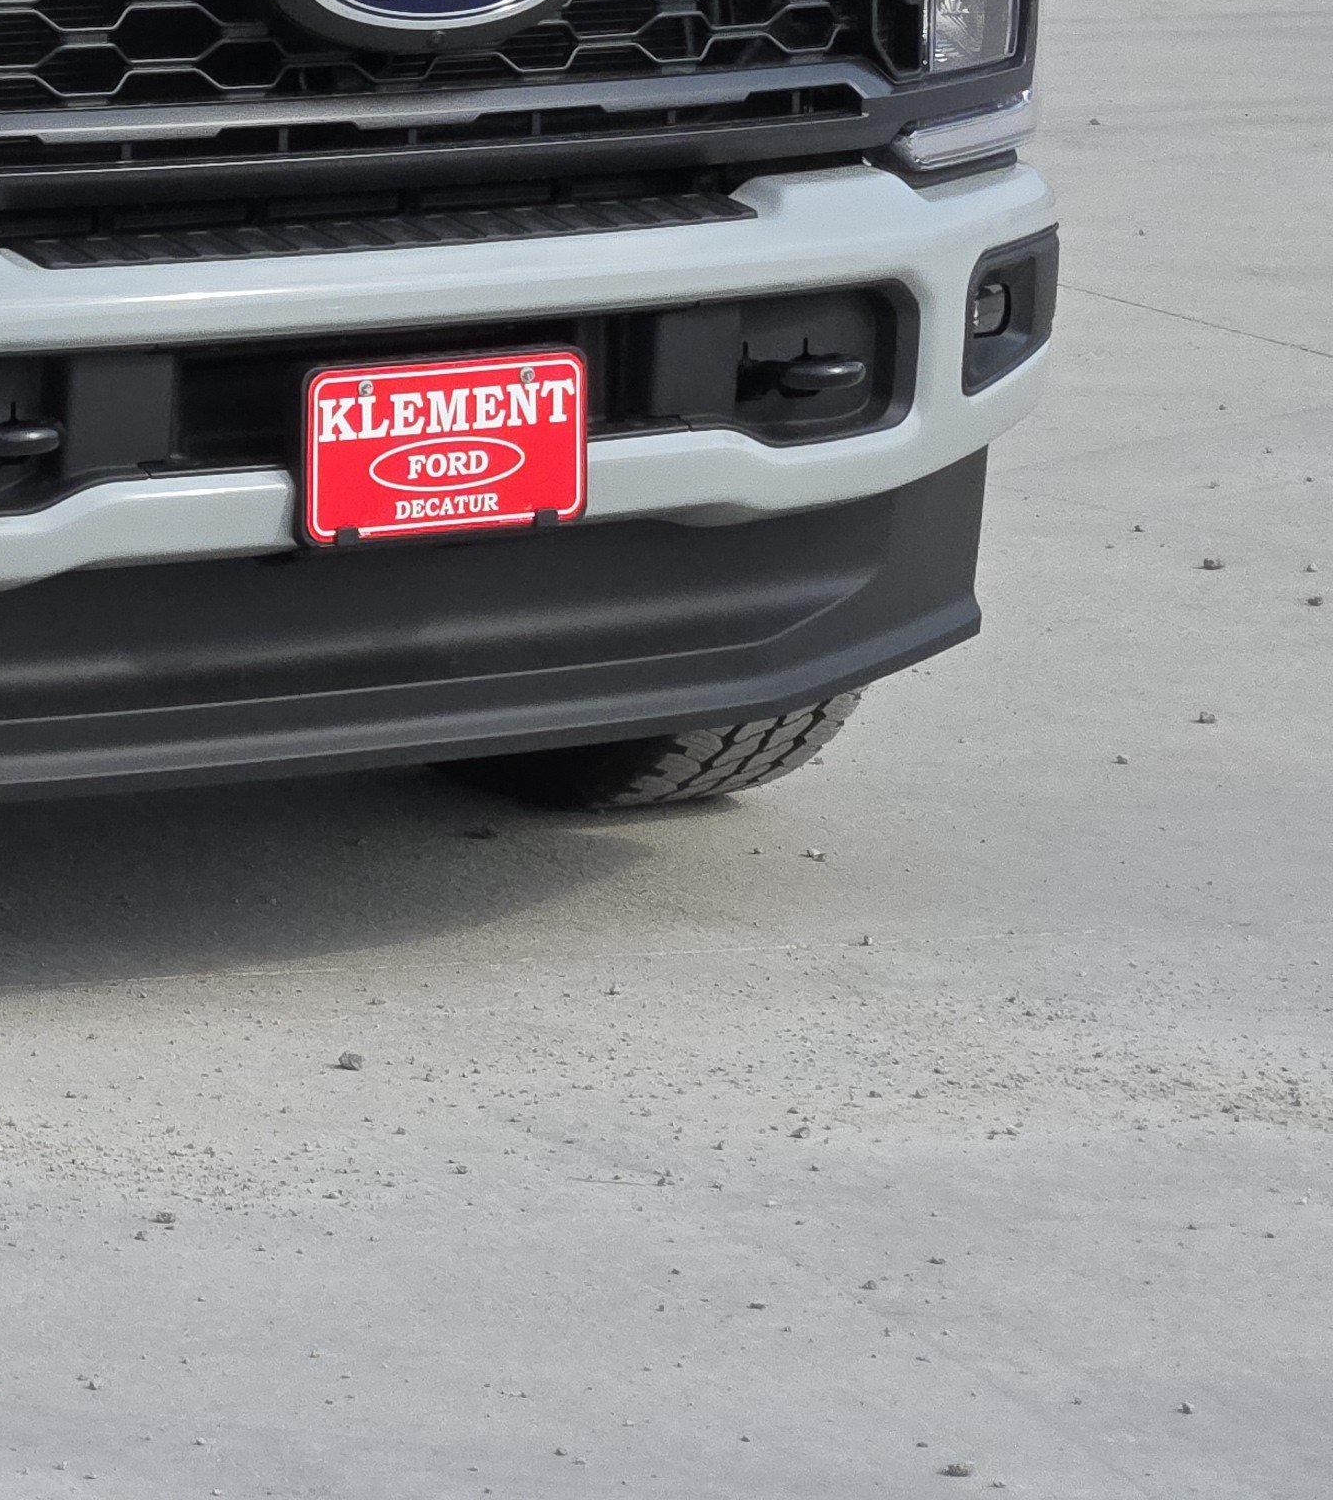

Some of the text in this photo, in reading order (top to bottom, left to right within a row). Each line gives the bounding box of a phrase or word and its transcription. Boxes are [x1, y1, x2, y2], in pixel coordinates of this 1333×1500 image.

[318, 379, 575, 443] KLEMENT
[407, 449, 489, 480] FORD
[395, 493, 499, 520] DECATUR
